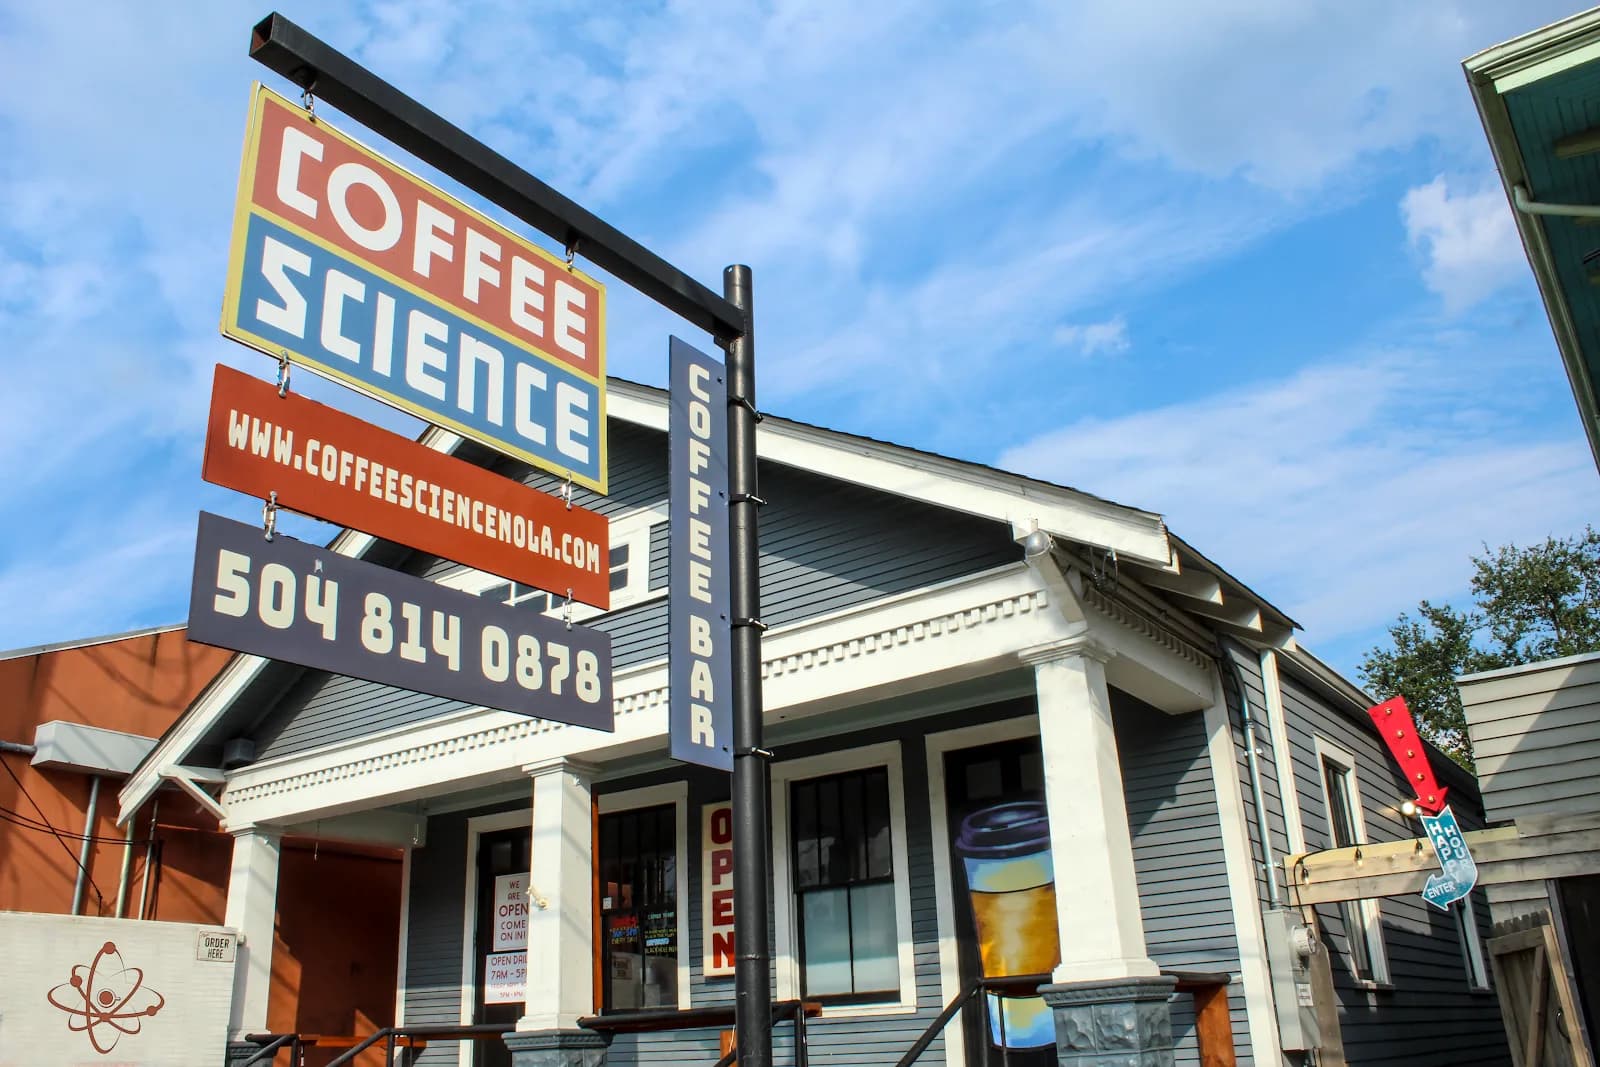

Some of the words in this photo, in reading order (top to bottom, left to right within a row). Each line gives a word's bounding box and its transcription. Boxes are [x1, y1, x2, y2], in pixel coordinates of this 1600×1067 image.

[276, 126, 586, 360] COFFEE
[256, 235, 589, 464] SCIENCE
[228, 409, 600, 574] WWW.COFFEESCIENCENOLA.COM
[689, 364, 712, 604] COFFEE
[214, 549, 339, 642] 504
[361, 592, 461, 672] 814
[481, 625, 602, 704] 0878
[689, 615, 715, 748] BAR
[1429, 821, 1463, 884] HAPPY
[1444, 825, 1471, 872] HOUR
[509, 880, 520, 889] WE
[711, 808, 737, 968] OPEN
[1427, 881, 1456, 899] ENTER
[507, 892, 520, 900] ARE
[499, 903, 529, 917] OPEN
[501, 920, 526, 930] COME
[205, 937, 230, 949] ORDER
[501, 932, 513, 941] ON
[207, 948, 223, 959] HERE
[491, 956, 511, 967] OPEN
[513, 954, 528, 965] DAIL
[491, 970, 508, 980] 7AM
[516, 968, 528, 978] 5P
